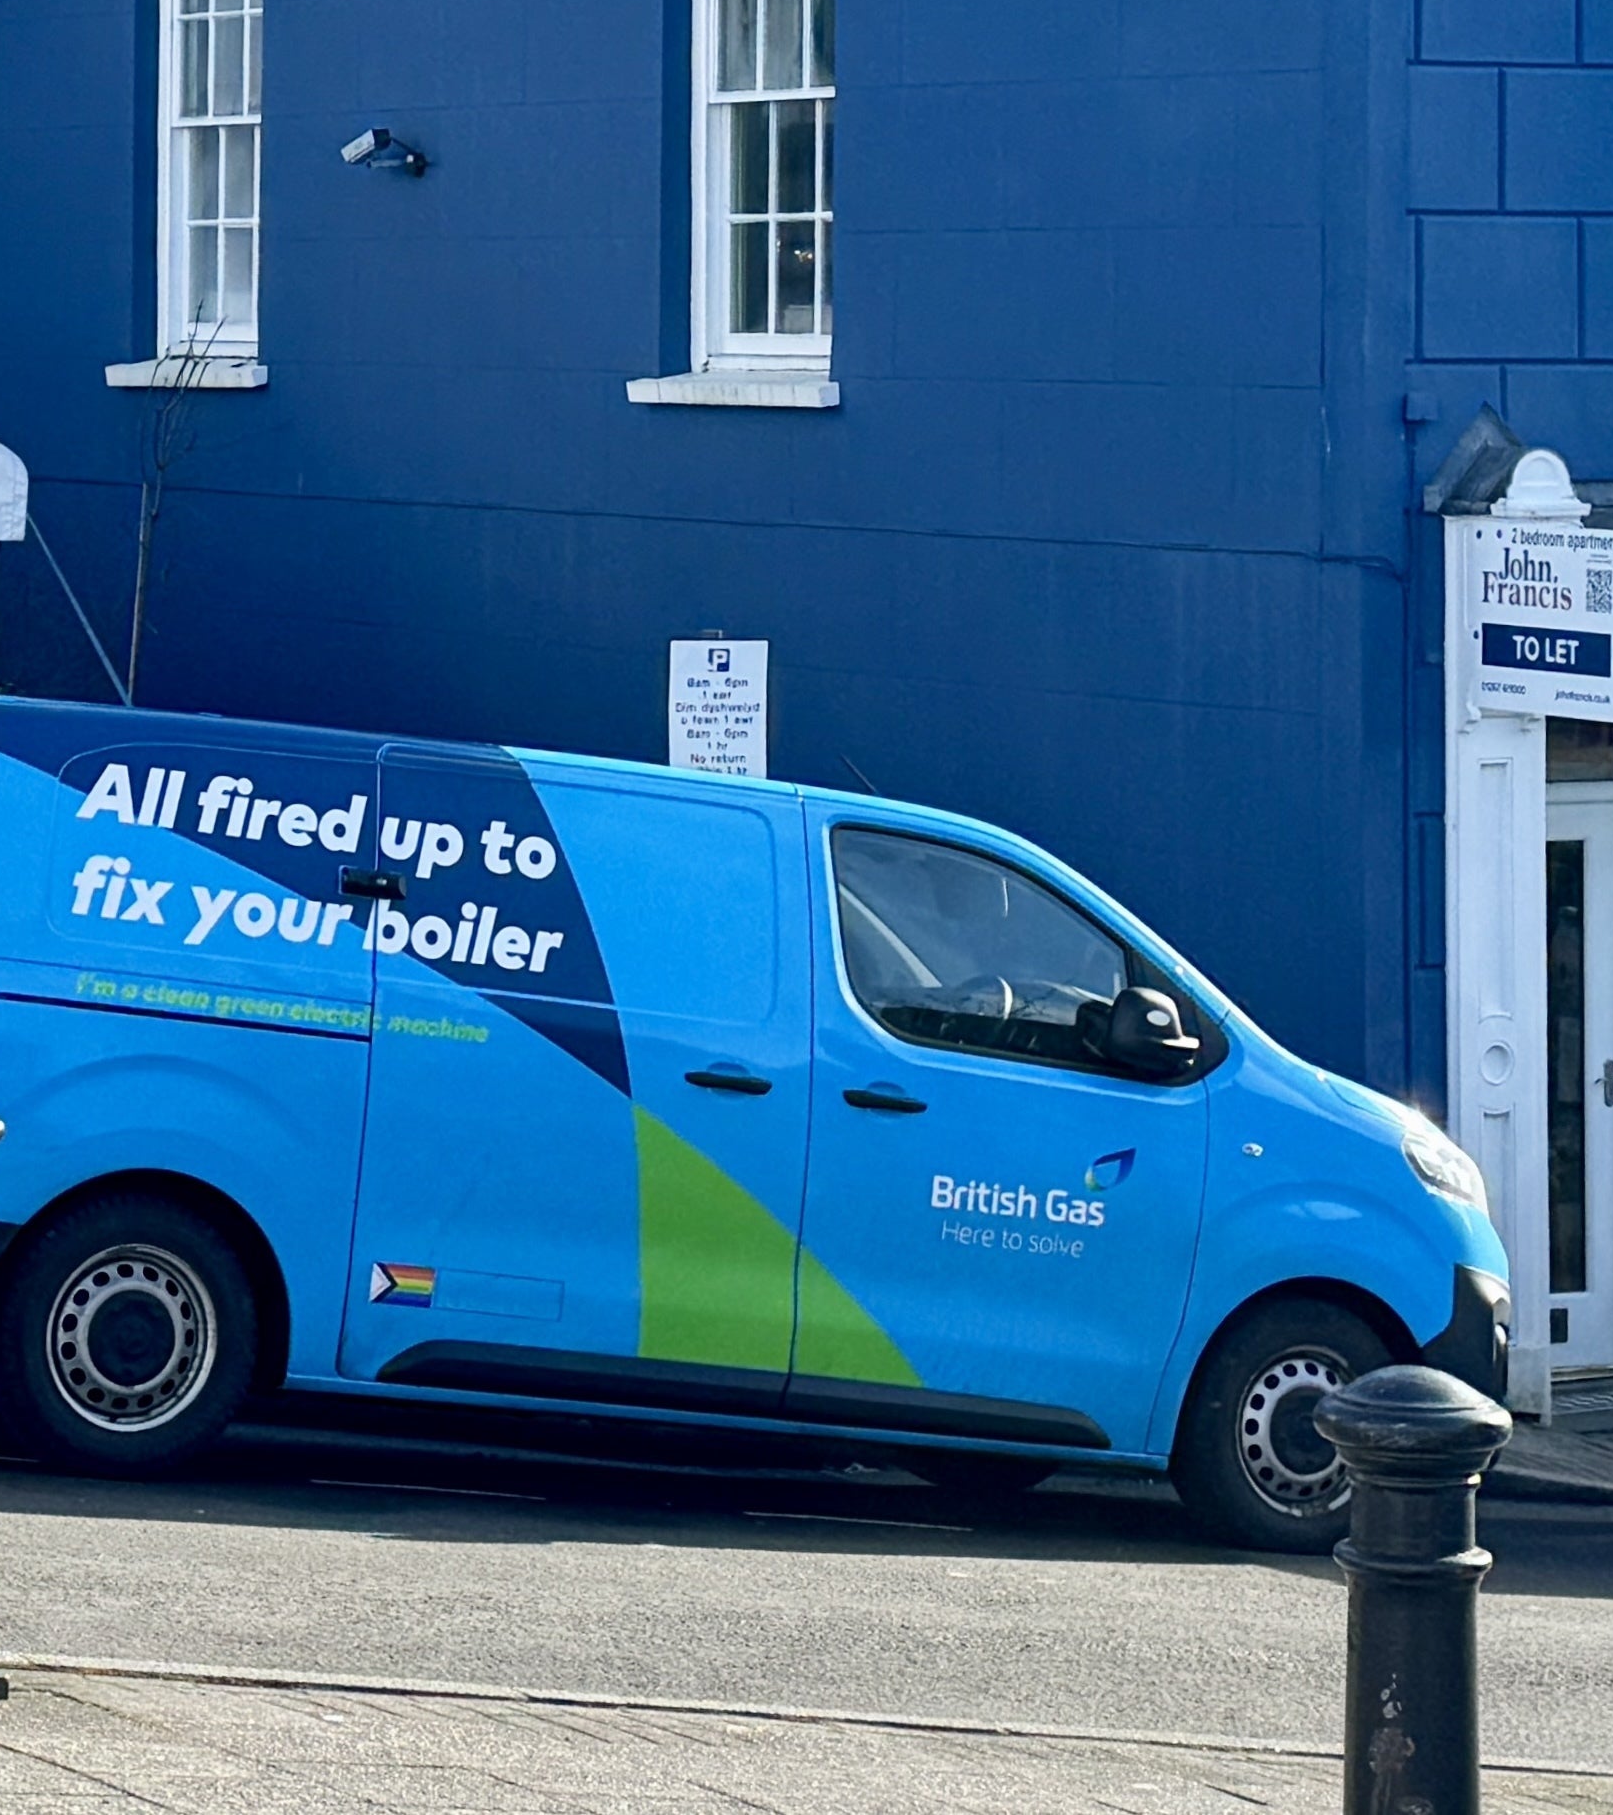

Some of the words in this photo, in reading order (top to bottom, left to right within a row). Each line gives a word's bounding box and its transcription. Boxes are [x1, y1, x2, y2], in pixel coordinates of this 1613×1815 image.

[1512, 528, 1518, 545] 2
[1520, 528, 1565, 548] bedroom
[1482, 571, 1572, 611] Francis
[1512, 635, 1540, 662] TO
[1544, 637, 1580, 665] LET
[690, 753, 706, 764] No
[711, 753, 746, 763] return
[76, 763, 186, 829] All
[197, 775, 368, 854] fired
[380, 816, 465, 879] up
[480, 820, 557, 880] to
[71, 855, 174, 926] fix
[183, 885, 354, 946] your
[362, 893, 565, 973] boiler
[76, 973, 117, 995] I'm
[121, 983, 139, 1000] a
[143, 980, 210, 1009] clean
[215, 993, 284, 1019] green
[289, 1000, 382, 1030] electric
[388, 1015, 489, 1043] machine
[930, 1174, 1036, 1219] British
[1045, 1189, 1105, 1227] Gas
[941, 1220, 995, 1248] Here
[1001, 1228, 1023, 1251] to
[1028, 1234, 1085, 1258] solve
